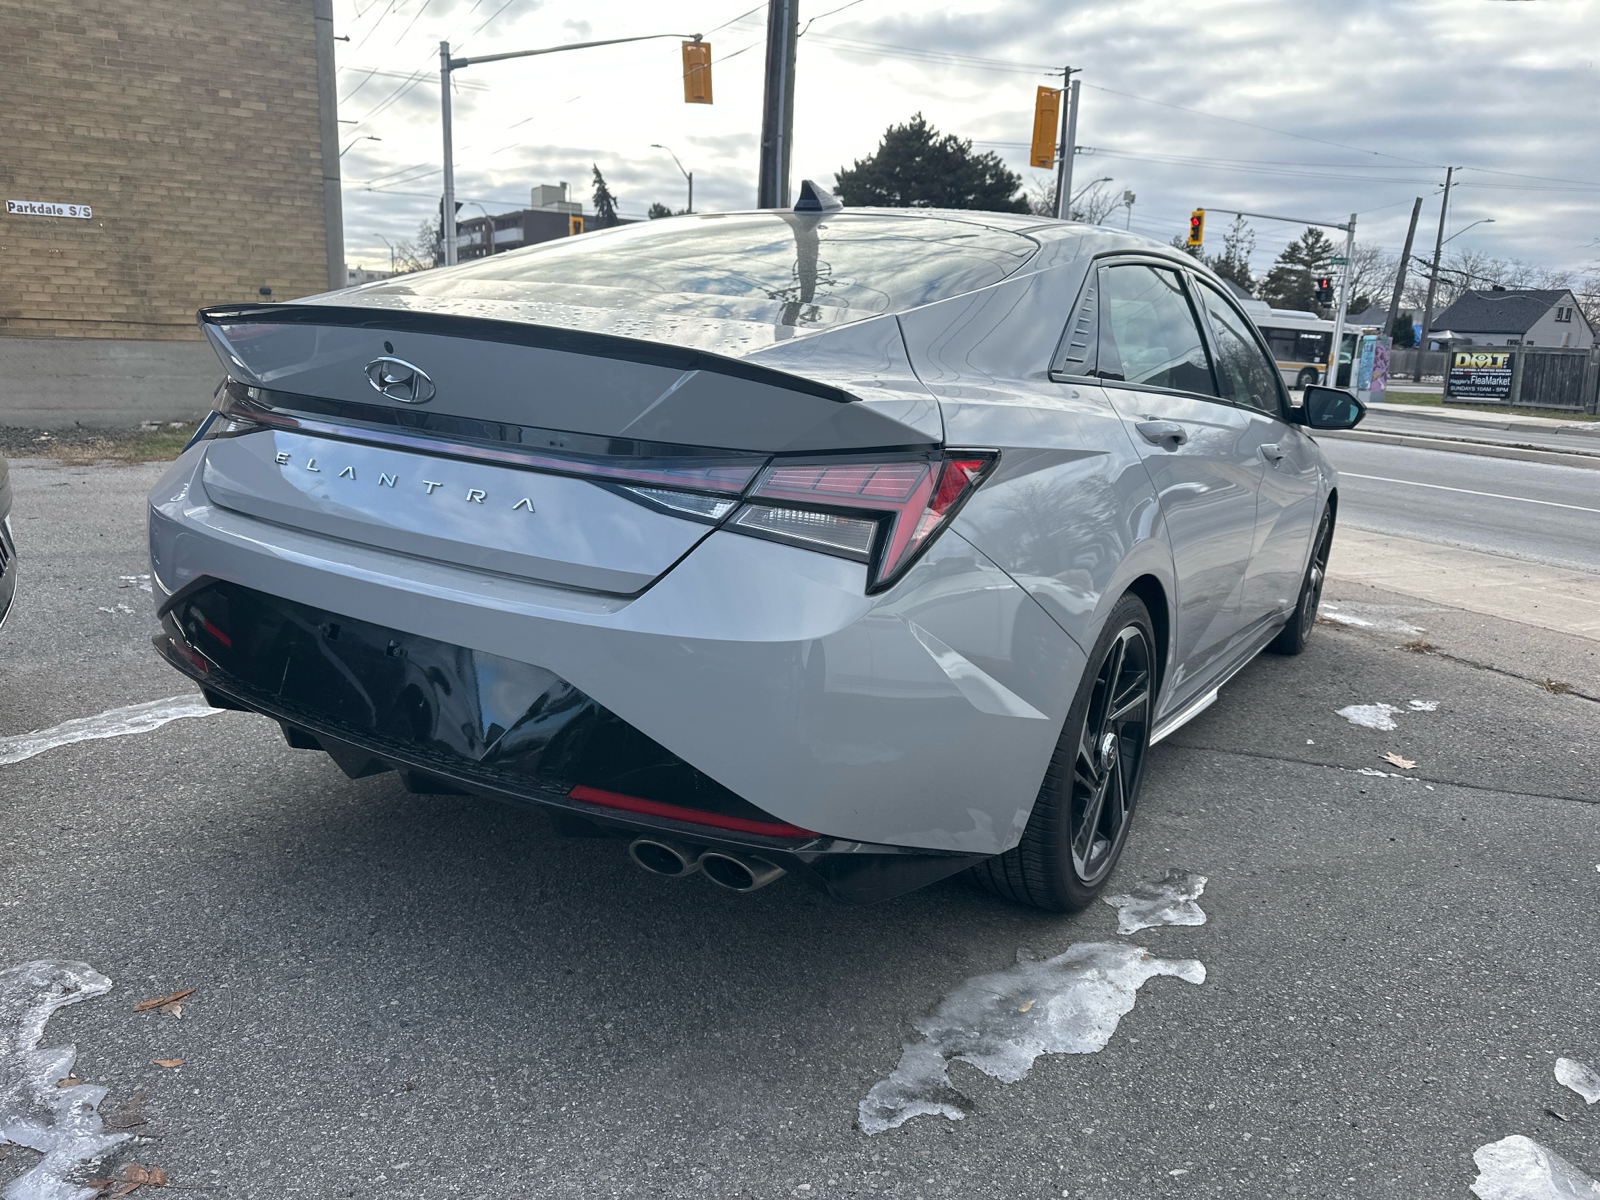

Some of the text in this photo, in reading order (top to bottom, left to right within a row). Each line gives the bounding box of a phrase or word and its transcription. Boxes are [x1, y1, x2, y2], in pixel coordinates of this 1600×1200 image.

[8, 202, 91, 217] Parkdale S/S
[1471, 375, 1510, 386] FleaMarket
[275, 452, 535, 513] ELANTRA
